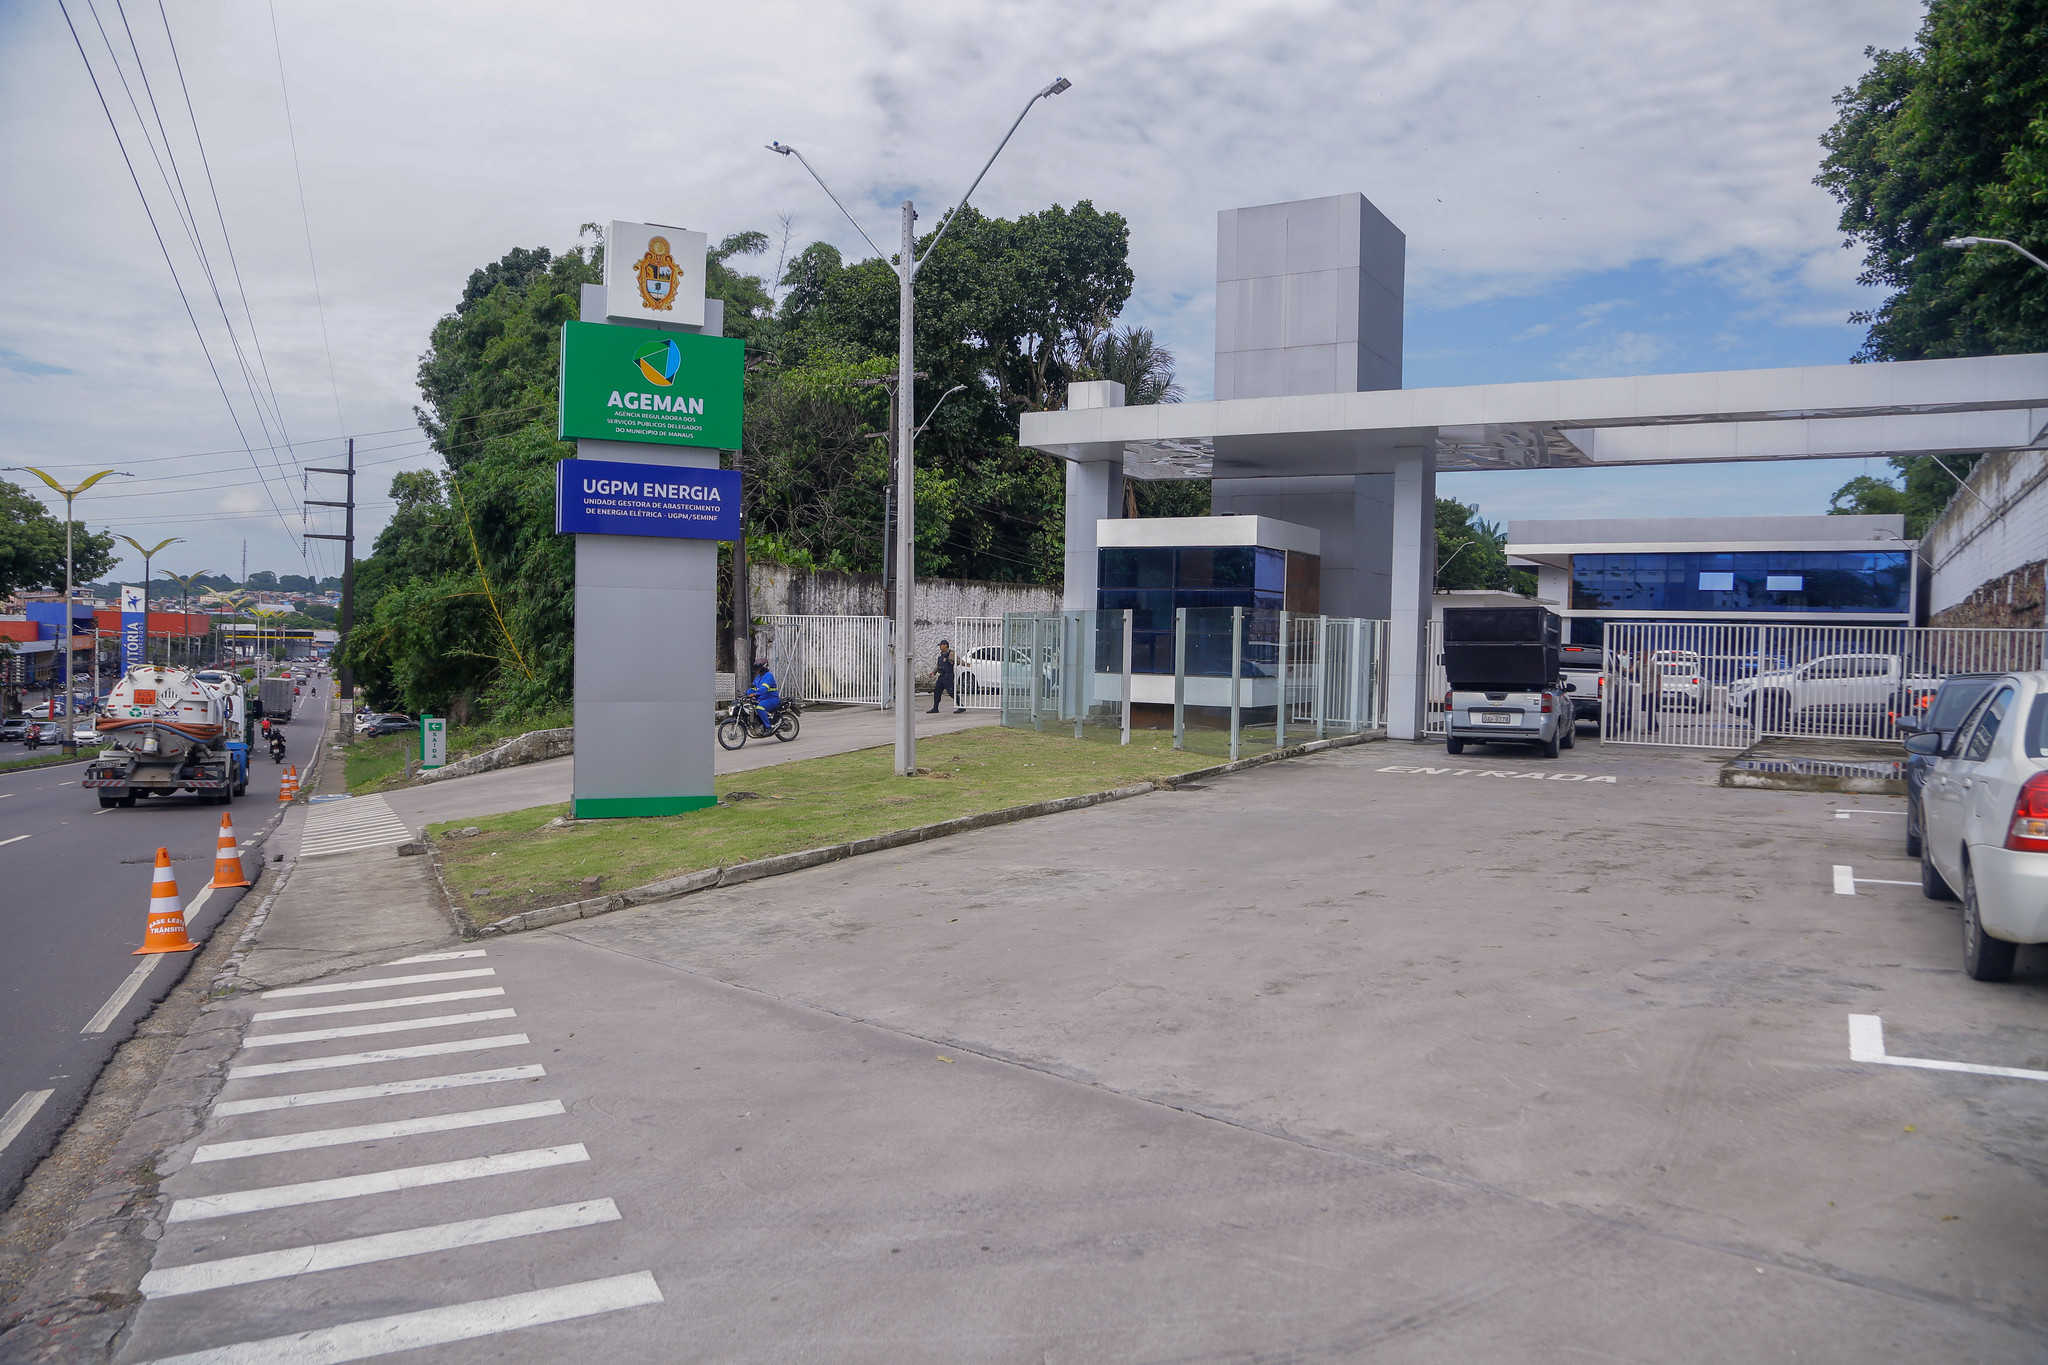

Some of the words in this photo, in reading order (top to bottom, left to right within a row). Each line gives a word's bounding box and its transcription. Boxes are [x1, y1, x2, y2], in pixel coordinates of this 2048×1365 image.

[607, 390, 704, 415] AGEMAN
[642, 413, 682, 422] REGULADORA
[606, 418, 636, 426] SERVIÇOS
[637, 420, 666, 428] PÚBLICOS
[667, 423, 702, 431] DELEGADOS
[626, 428, 658, 436] MUNICÍPIO
[583, 478, 638, 496] UGPM
[643, 482, 721, 502] ENERGIA
[583, 498, 617, 506] UNIDADE
[618, 500, 651, 508] GESTORA
[662, 503, 721, 512] ABASTECIMENTO
[597, 508, 628, 516] ENERGIA
[629, 509, 662, 518] ELÉTRICA
[668, 512, 719, 521] UGPM/SEMINF
[123, 622, 139, 668] VITÓRIA
[1375, 766, 1617, 783] ENTRADA
[150, 926, 184, 934] TRÂNSITO
